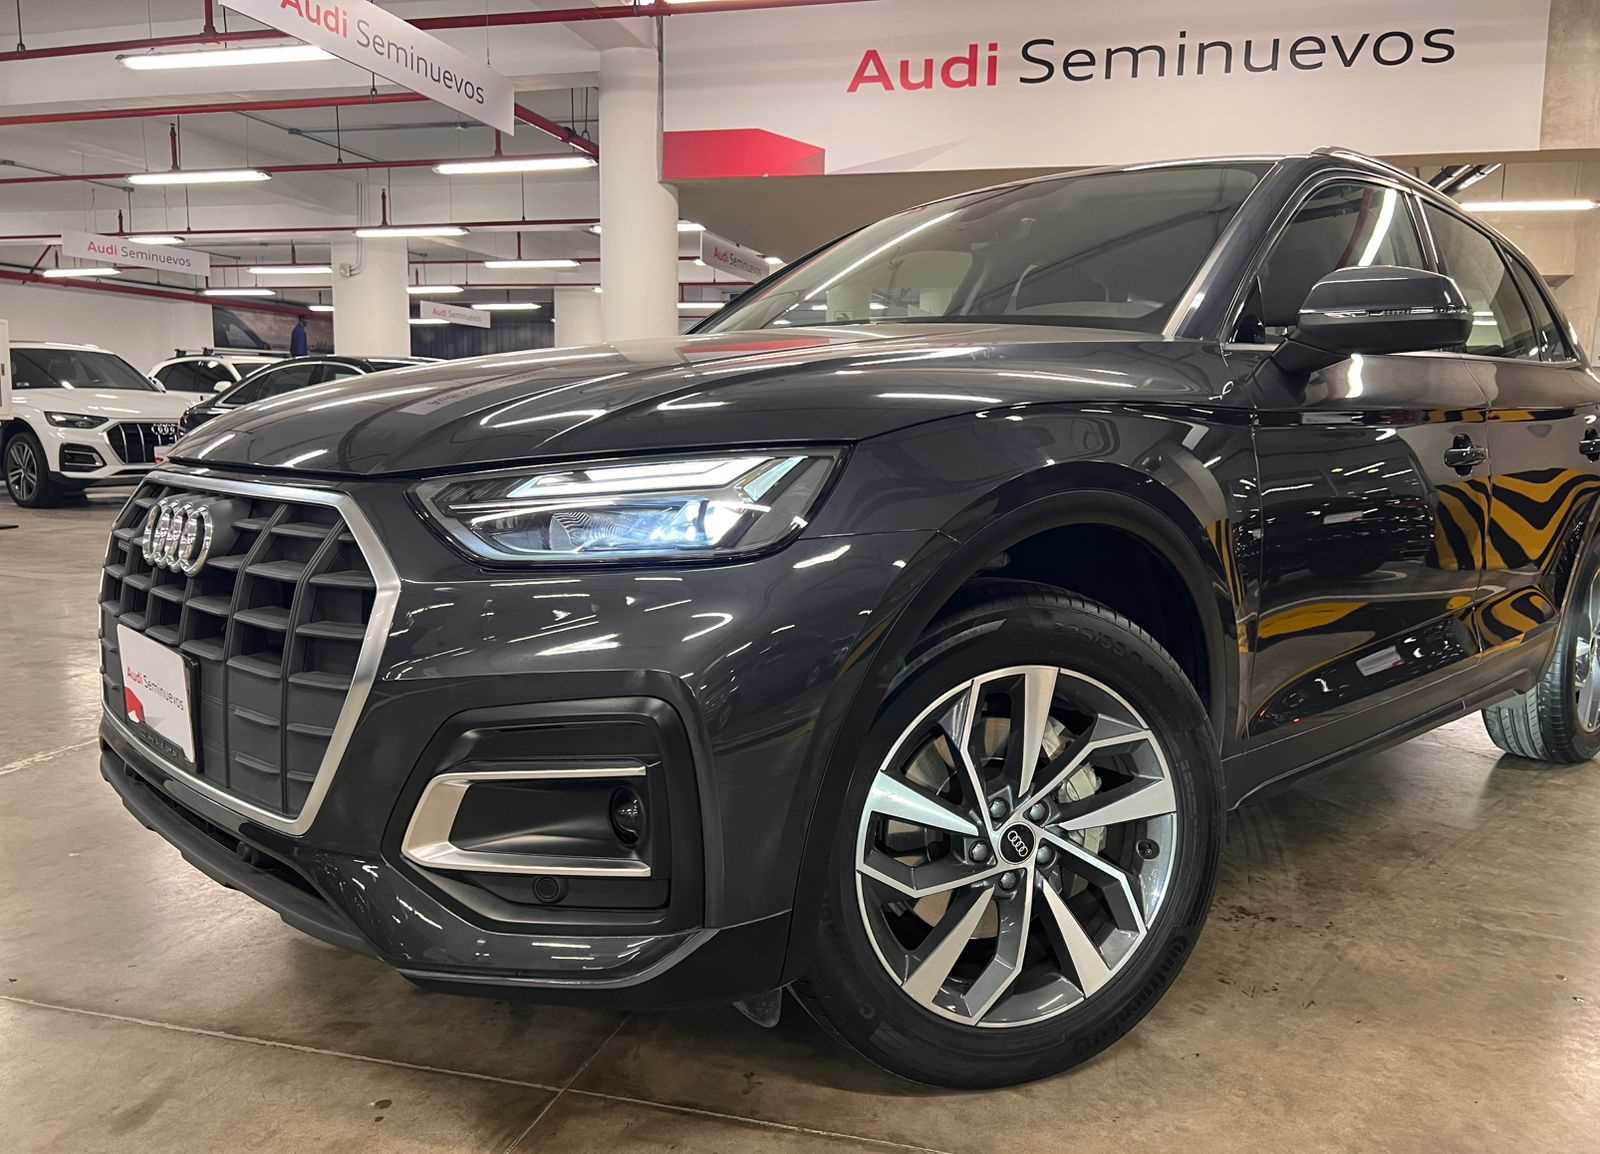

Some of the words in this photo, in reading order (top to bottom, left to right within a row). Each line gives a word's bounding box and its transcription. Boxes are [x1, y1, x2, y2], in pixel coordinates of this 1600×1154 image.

[356, 18, 485, 104] Seminuevos
[847, 42, 998, 93] Audi
[1019, 28, 1456, 84] Seminuevos
[87, 241, 118, 255] Audi
[120, 246, 192, 267] Seminuevos
